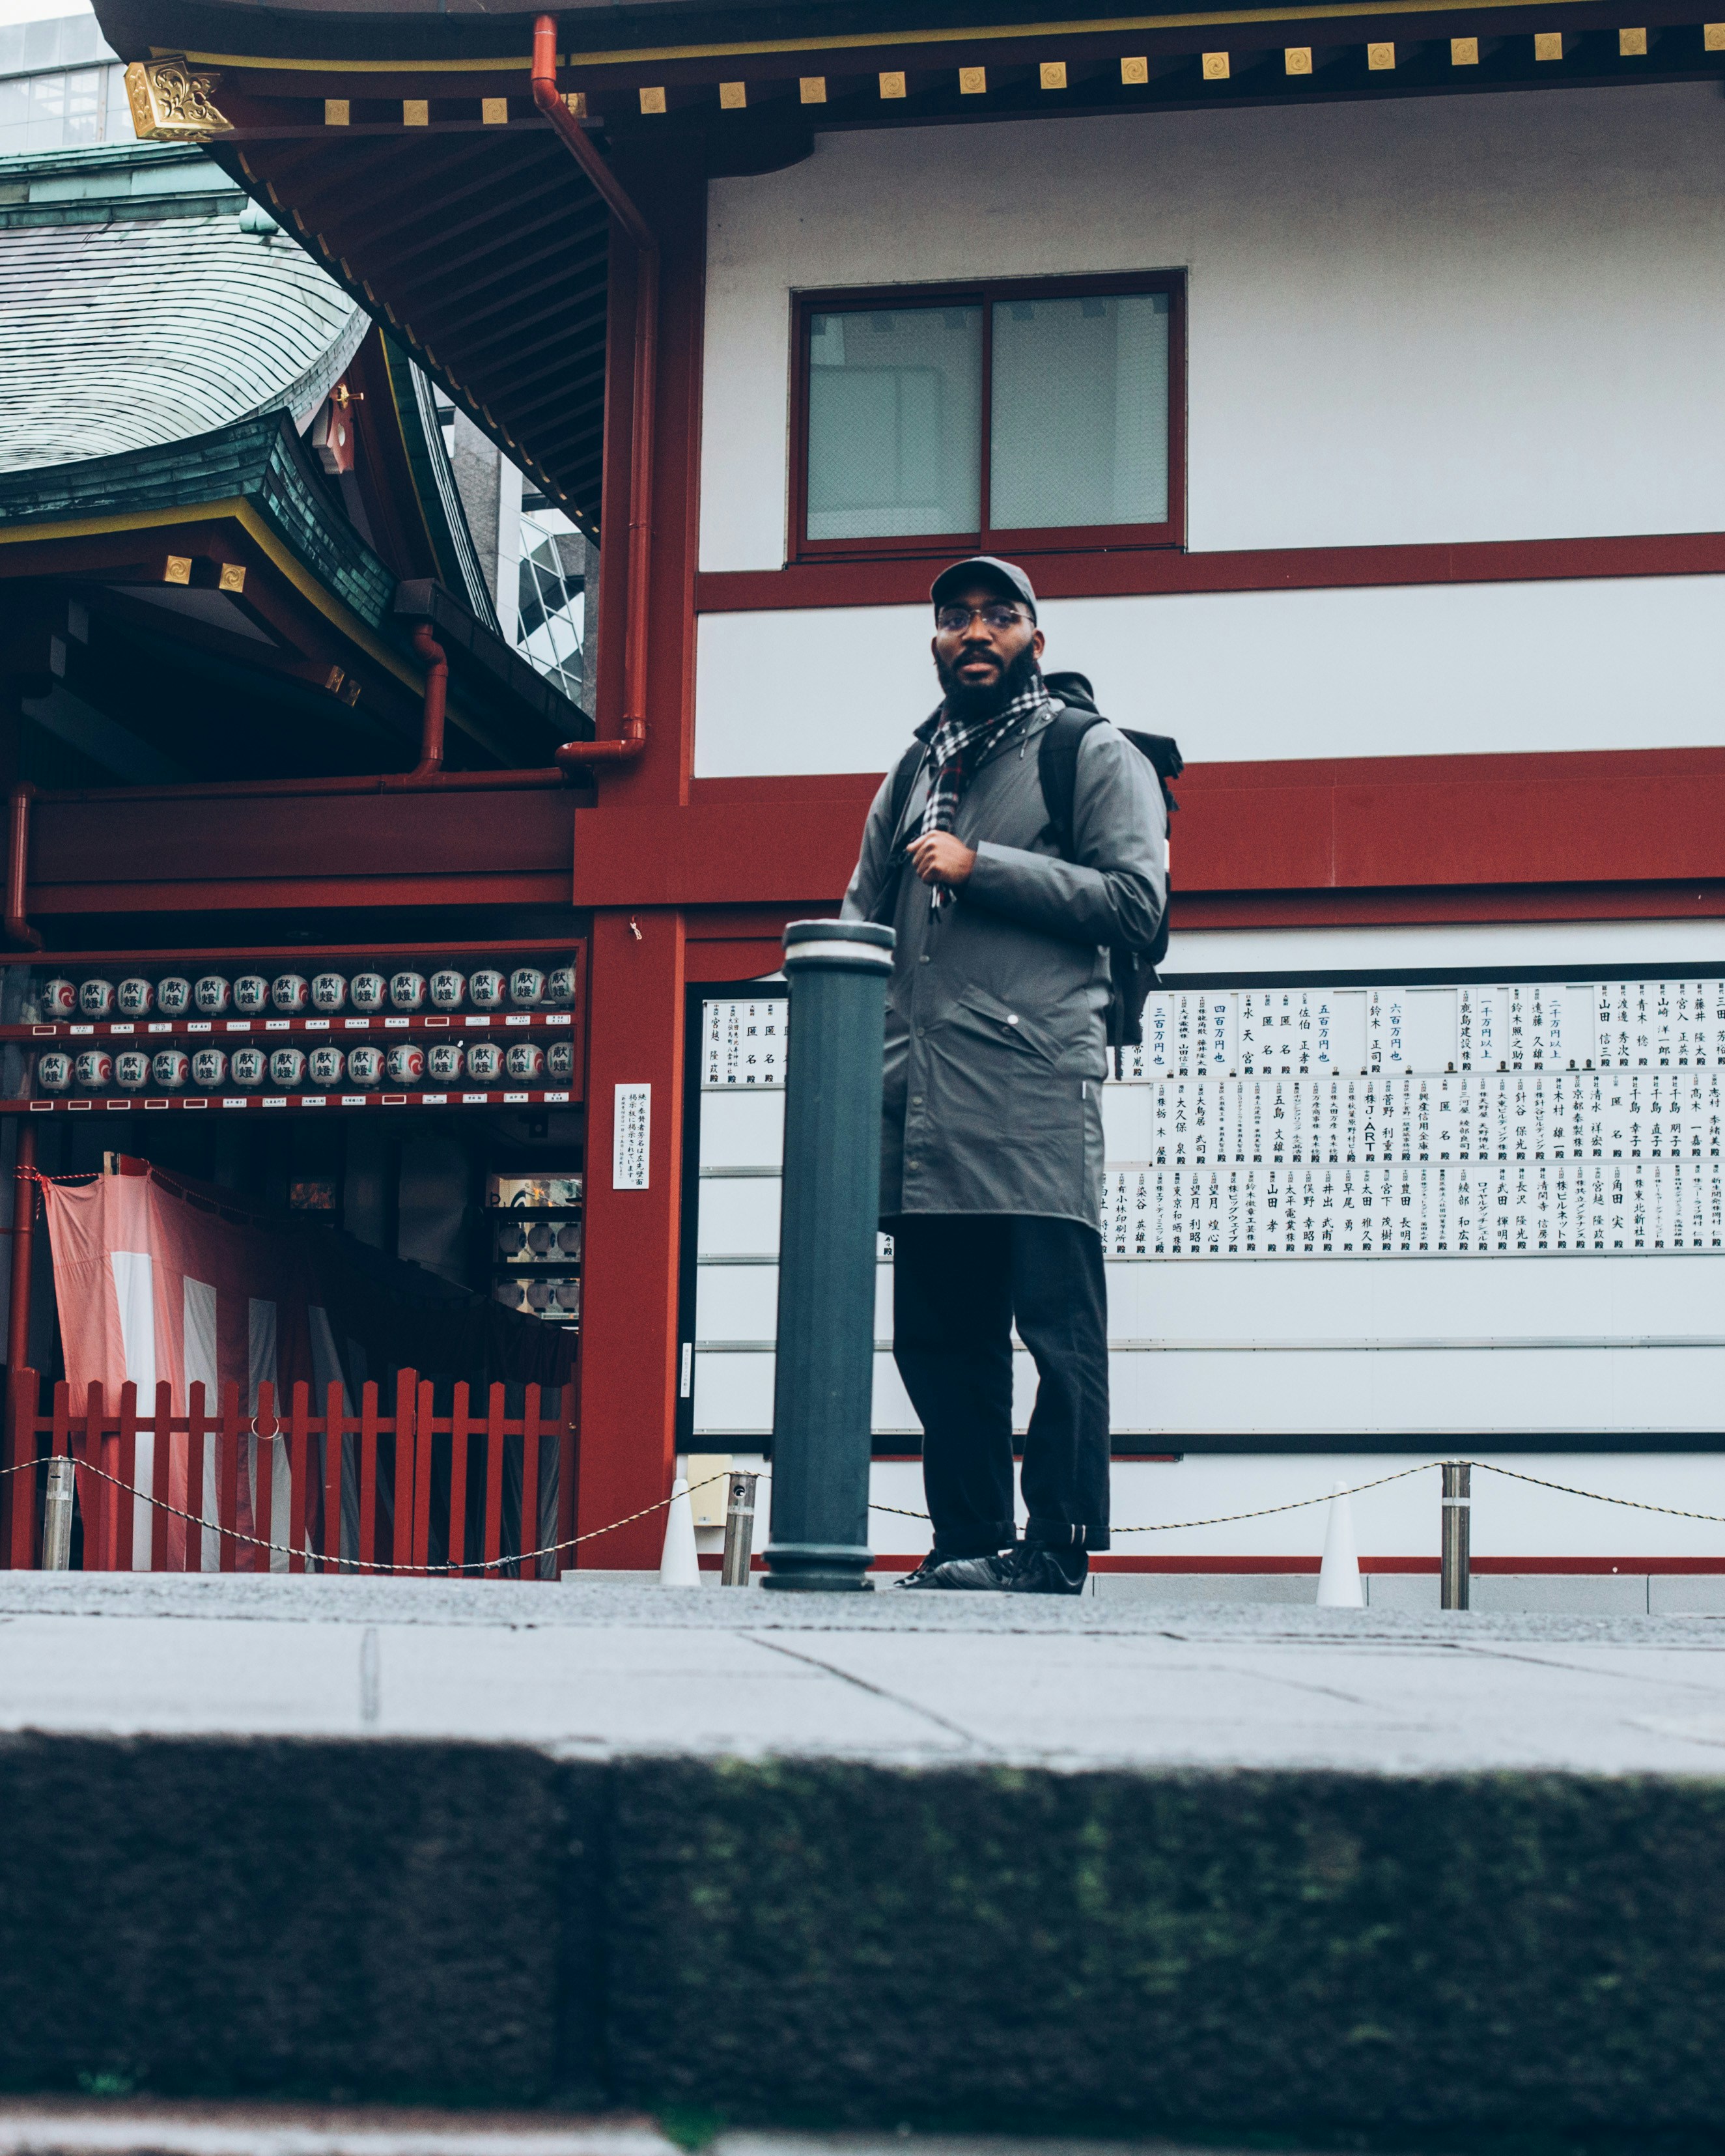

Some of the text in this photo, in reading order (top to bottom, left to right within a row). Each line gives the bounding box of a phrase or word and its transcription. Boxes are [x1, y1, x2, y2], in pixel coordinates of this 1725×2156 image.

[1153, 1008, 1166, 1065] 三百万円也
[1214, 1005, 1226, 1063] 四百万円也
[1242, 1007, 1254, 1074] 水天宮殿
[1262, 1016, 1274, 1074] 匿名殿
[1280, 1016, 1291, 1074] 匿名殿
[1318, 1005, 1330, 1062] 五百万円也
[1370, 1005, 1381, 1072] 鈴木正司殿
[1390, 1003, 1402, 1061] 六百万円也
[1481, 1001, 1493, 1058] 一千万円以上
[1511, 1003, 1523, 1070] 鈴木照之助殿
[1549, 1000, 1561, 1058] 二千万円以上
[1599, 999, 1611, 1067] 山田信三殿
[1676, 998, 1689, 1065] 宮入正英殿
[1175, 1097, 1186, 1164] 大久保泉殿
[1382, 1094, 1394, 1161] 菅野利重殿
[1418, 1093, 1429, 1161] 興産信用金庫殿
[1439, 1101, 1451, 1160] 匿名殿
[1553, 1090, 1565, 1158] 木村雄一殿
[1611, 1097, 1622, 1157] 匿名殿
[1135, 1186, 1147, 1253] 染谷英雄殿
[1189, 1185, 1201, 1253] 望月利昭殿
[1267, 1184, 1278, 1252] 山田孝殿
[1612, 1179, 1623, 1248] 角田実殿
